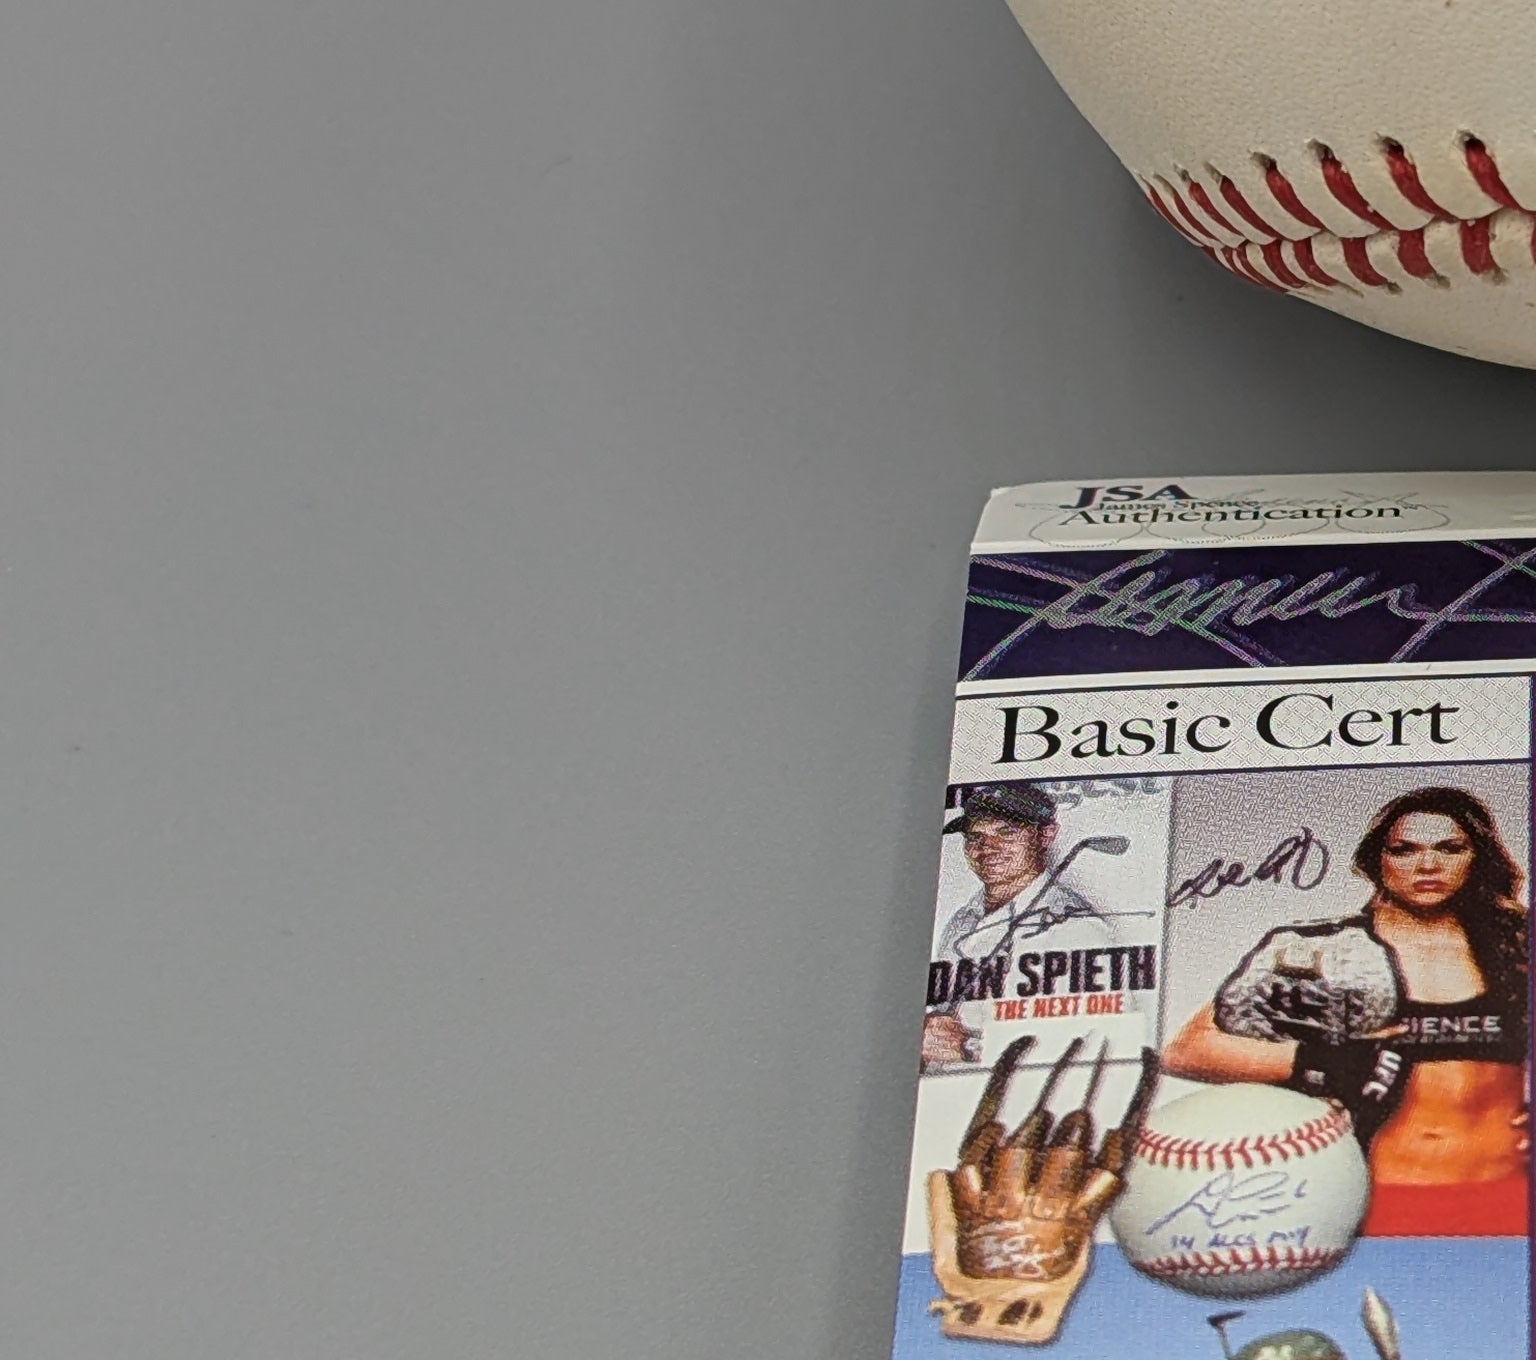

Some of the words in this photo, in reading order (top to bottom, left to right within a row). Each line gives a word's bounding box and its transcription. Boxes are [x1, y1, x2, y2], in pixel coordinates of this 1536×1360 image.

[1060, 485, 1196, 509] JSA
[1060, 505, 1400, 525] Authentication
[992, 700, 1231, 765] Basic
[1255, 693, 1461, 750] Cert
[1016, 945, 1157, 996] SPIETH
[994, 999, 1028, 1020] THE
[1033, 995, 1080, 1018] NEXT
[1086, 993, 1123, 1014] ONE
